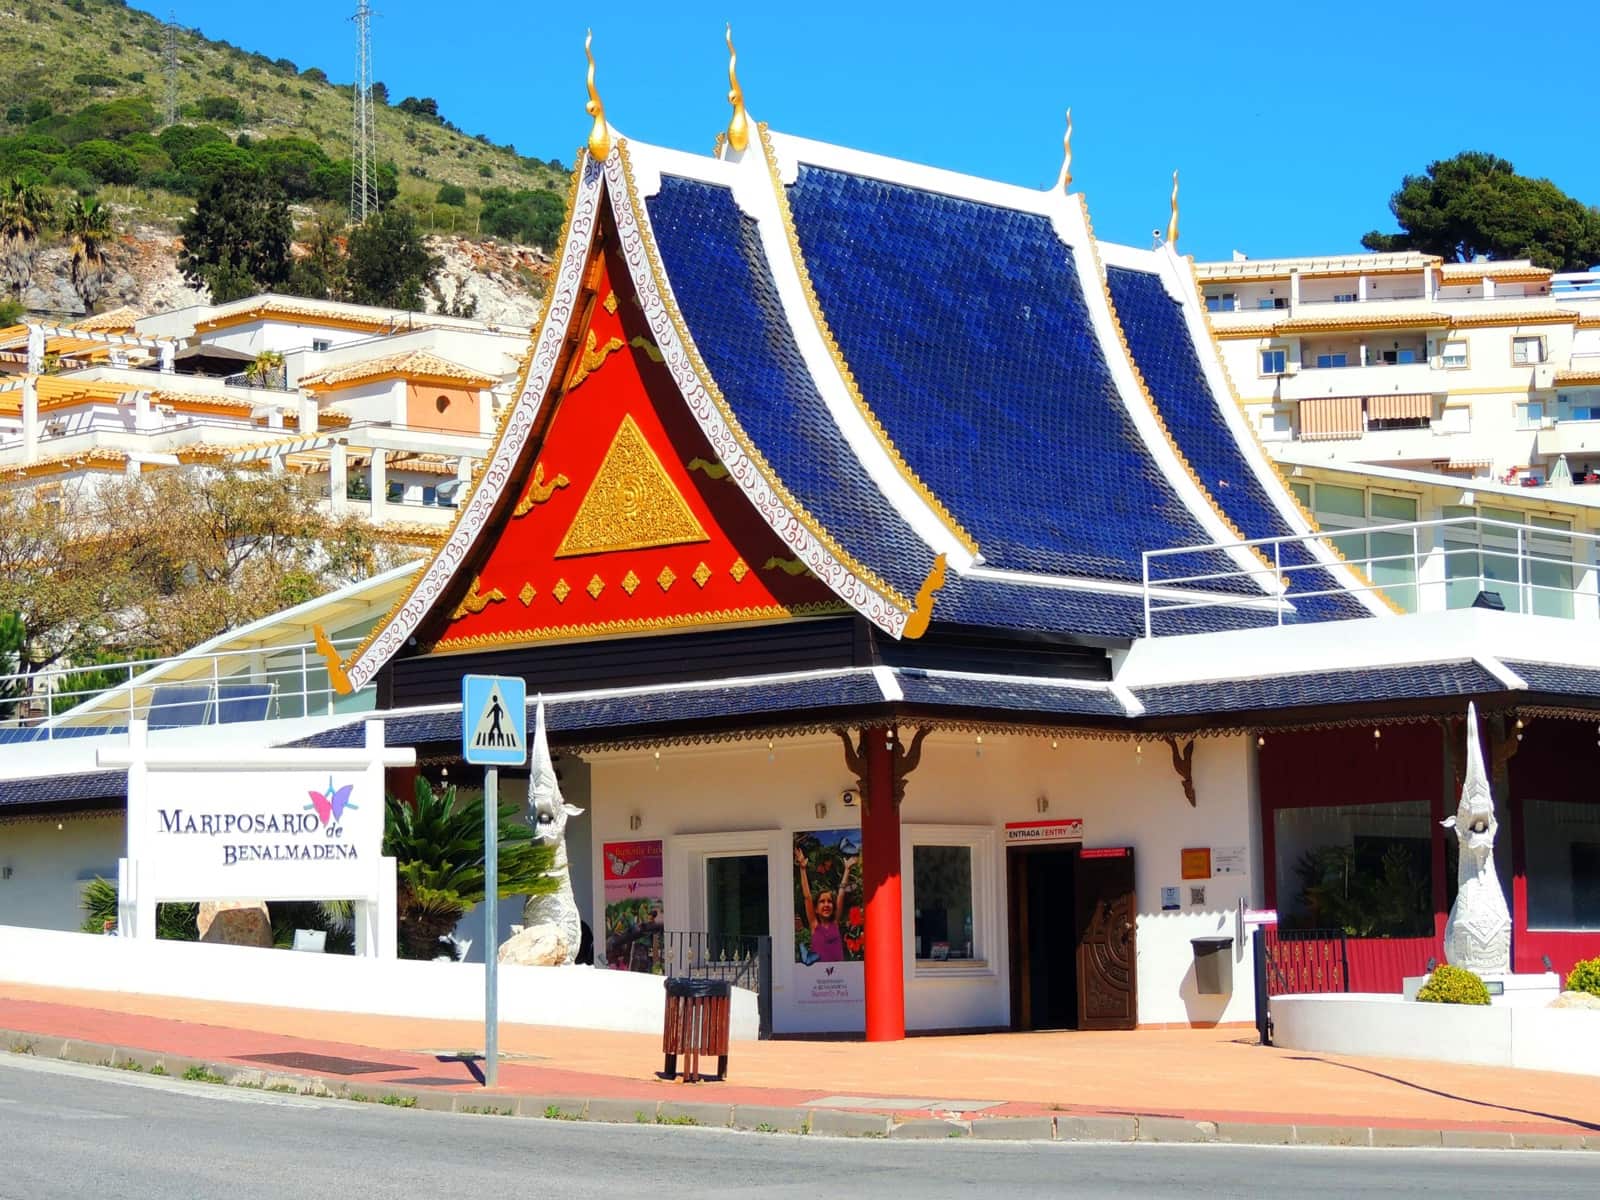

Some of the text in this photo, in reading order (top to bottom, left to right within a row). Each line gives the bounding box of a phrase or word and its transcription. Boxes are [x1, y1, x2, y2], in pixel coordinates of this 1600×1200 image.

[157, 808, 343, 838] MARIPOSARIO de
[1009, 830, 1040, 838] ENTRADA
[222, 845, 358, 867] BENALMADENA
